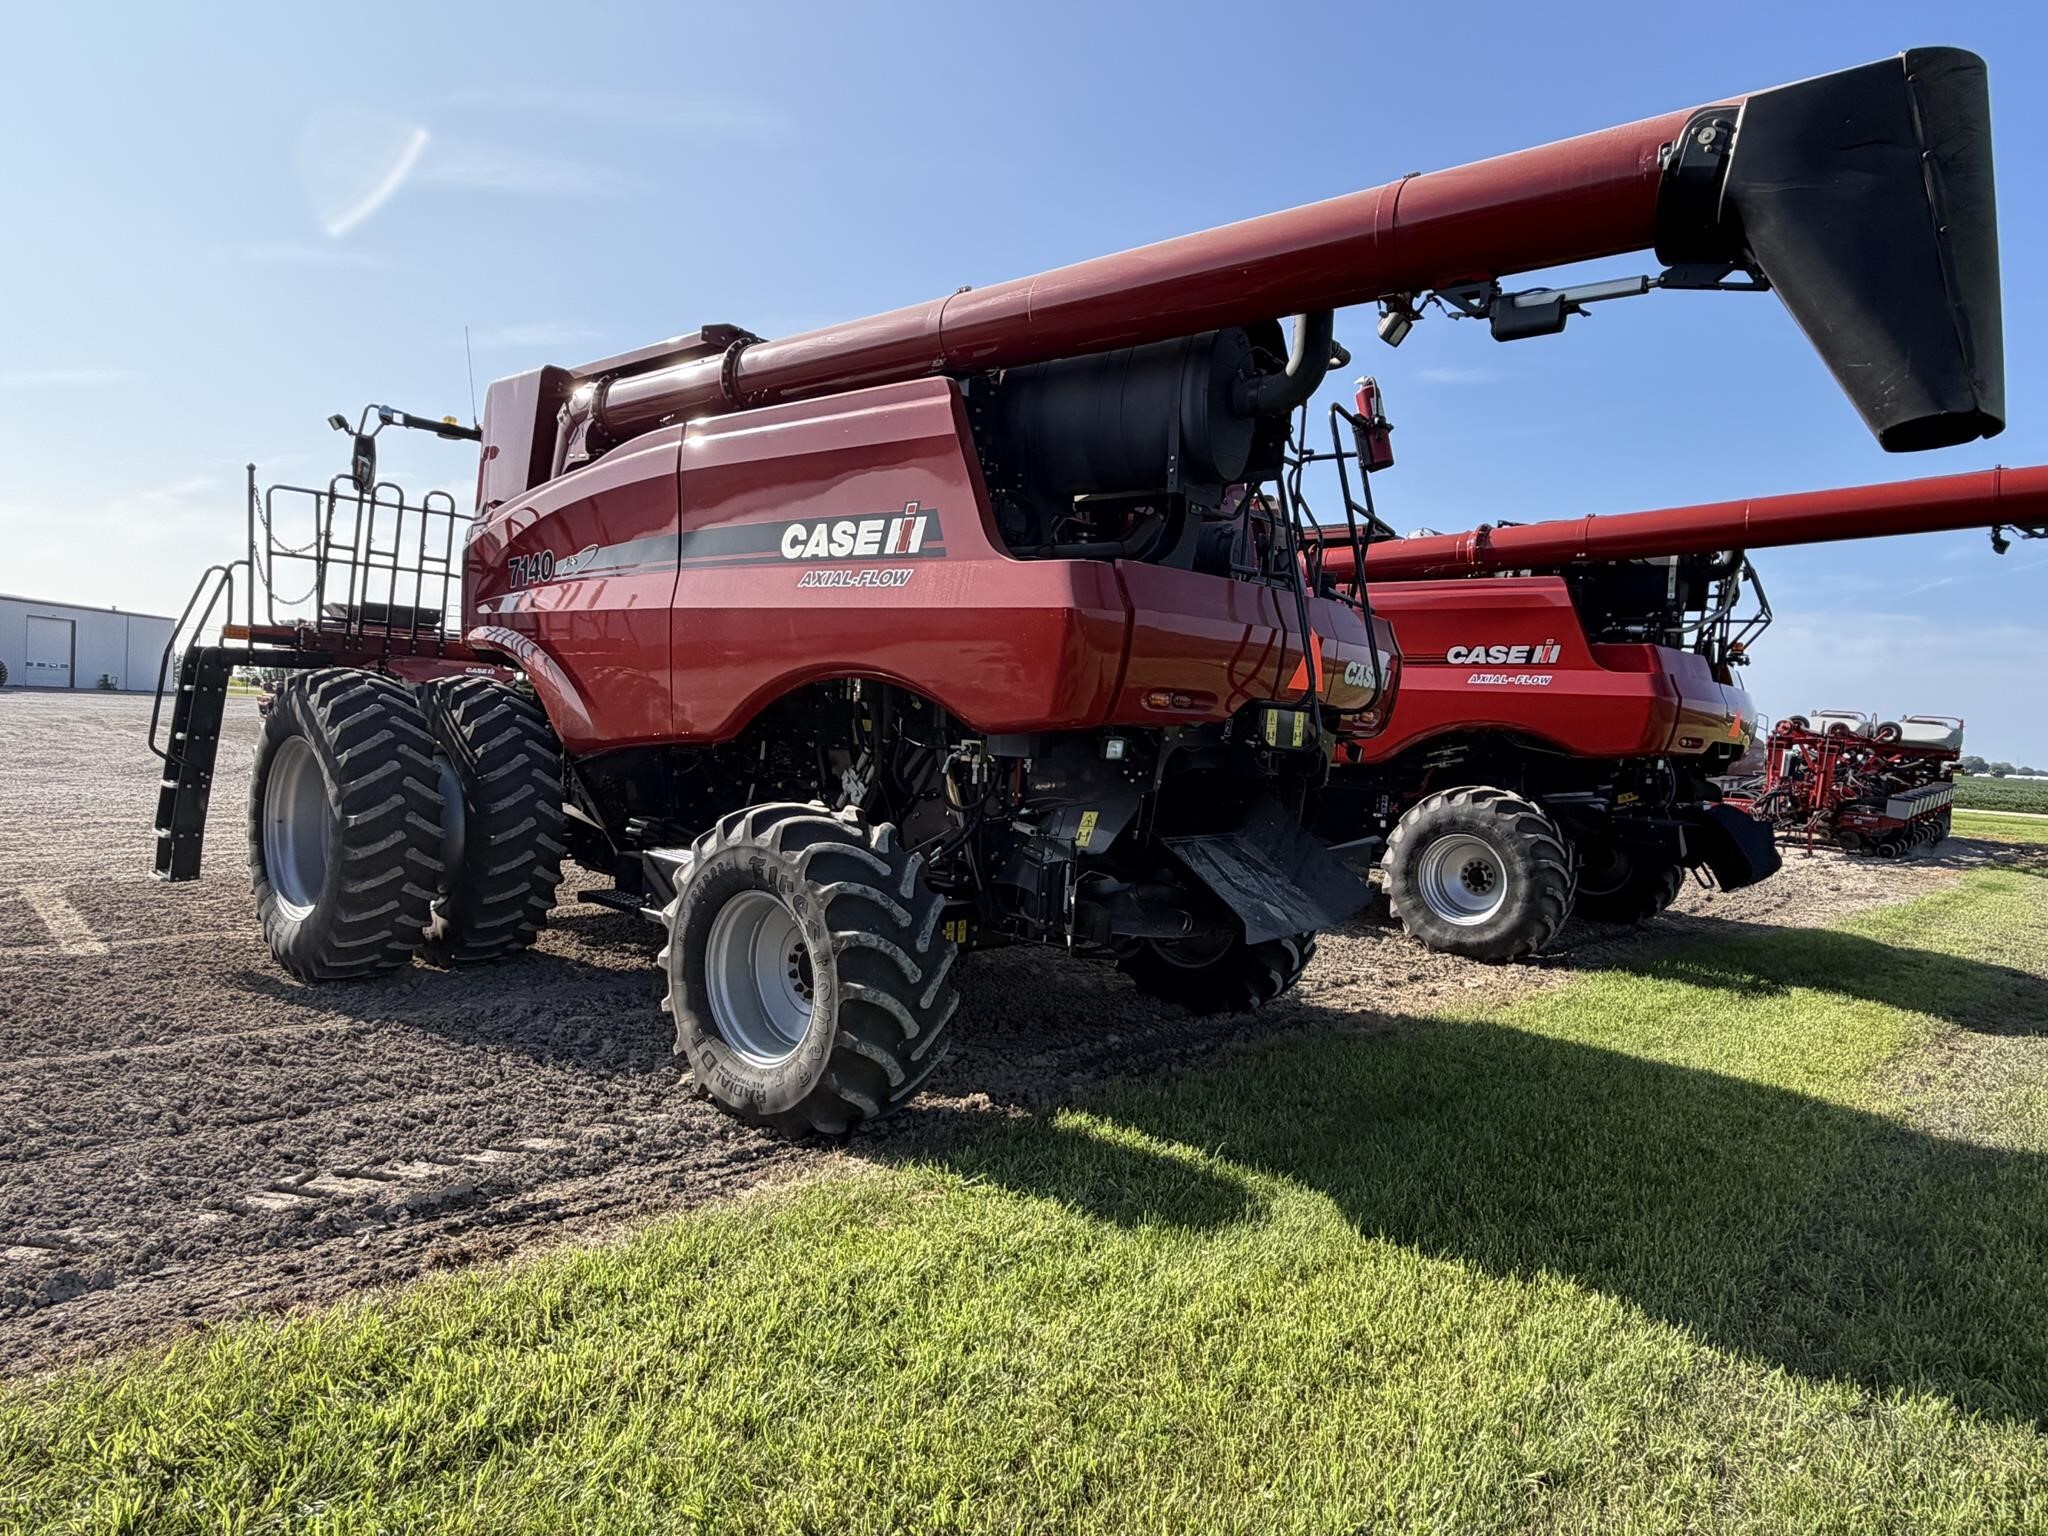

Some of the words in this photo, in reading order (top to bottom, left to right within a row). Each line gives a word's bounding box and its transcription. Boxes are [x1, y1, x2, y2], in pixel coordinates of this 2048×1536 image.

[781, 519, 885, 559] CASE
[508, 549, 555, 589] 7140
[797, 569, 914, 588] AXIAL-FLOW
[1446, 645, 1530, 664] CASE
[1467, 673, 1552, 686] AXIAL-FLOW
[715, 1069, 767, 1104] RADIAL
